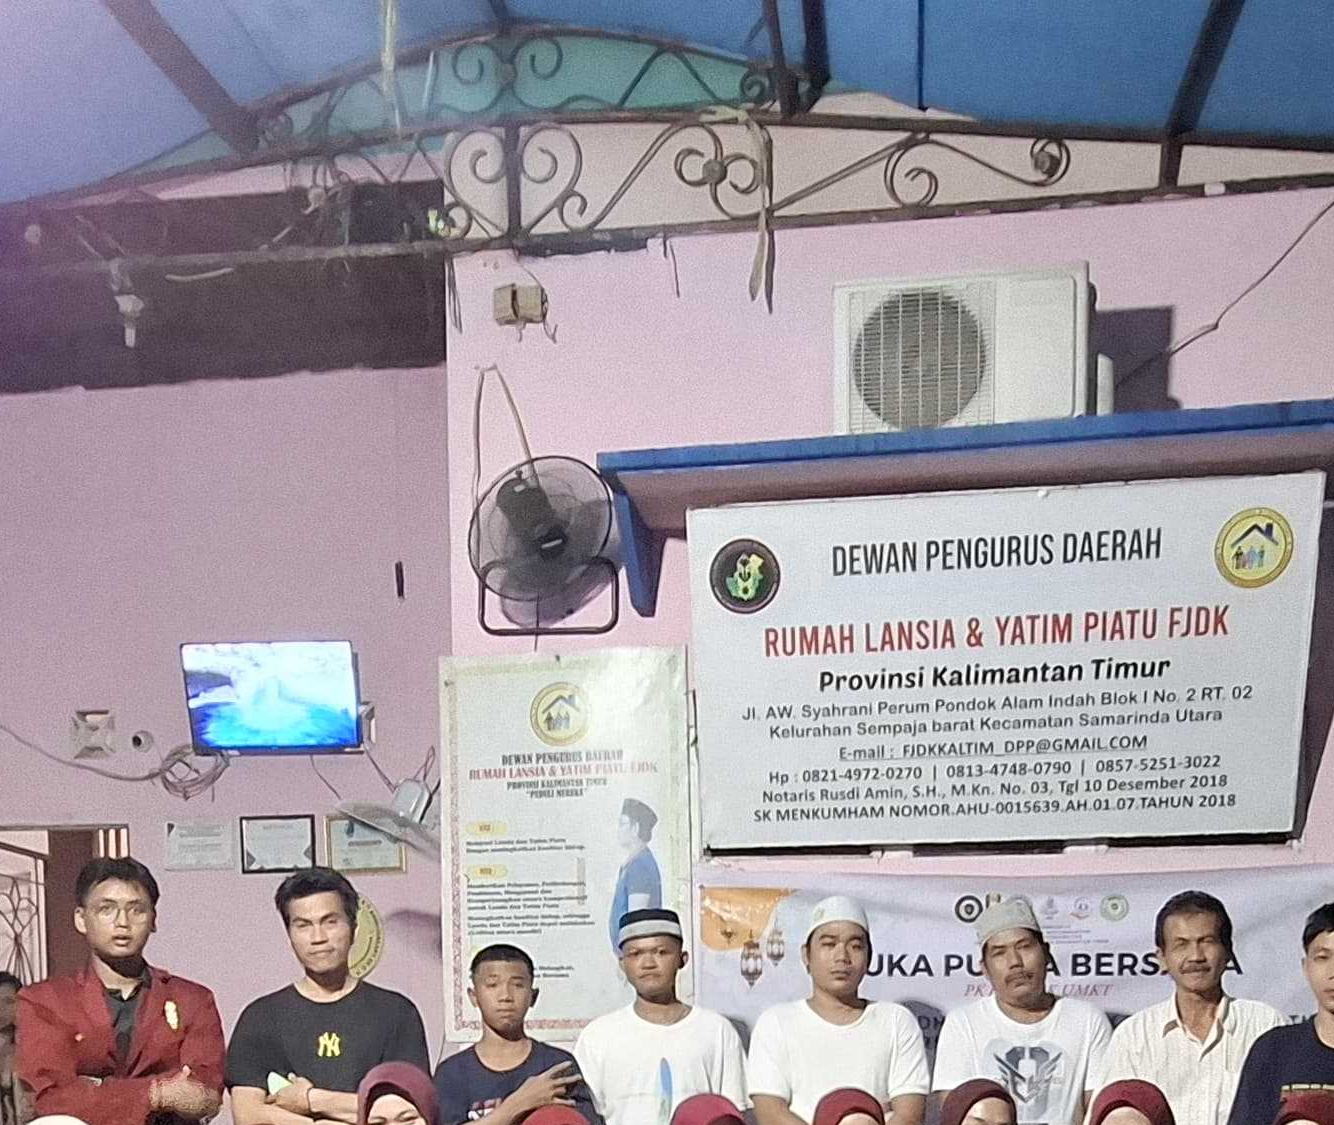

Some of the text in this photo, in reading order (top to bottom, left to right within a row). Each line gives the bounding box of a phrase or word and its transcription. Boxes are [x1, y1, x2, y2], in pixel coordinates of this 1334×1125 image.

[832, 527, 1163, 577] DEWAN PENGURUS DAERAH
[764, 605, 1230, 657] RUMAH LANSIA & YATIM PIATU FJDK
[819, 657, 1171, 693] Provinsi Kalimantan Timur
[801, 703, 873, 721] Syahrani
[877, 701, 930, 715] Perum
[935, 697, 997, 712] Pondok
[1001, 696, 1044, 710] Alam
[1049, 692, 1096, 708] Indah
[1101, 691, 1138, 706] Blok
[1186, 688, 1197, 702] 2
[1231, 685, 1253, 700] 02
[769, 708, 1223, 740] Kelurahan Sempaja barat Kecamatan Samarinda Utara
[839, 744, 885, 761] E-mail
[769, 770, 790, 786] Hp
[802, 766, 923, 783] 0821-4972-0270
[946, 760, 1072, 778] 0813-4748-0790
[1095, 754, 1221, 773] 0857-5251-3022
[762, 788, 816, 804] Notaris
[820, 786, 860, 802] Rusdi
[864, 785, 908, 801] Amin,
[1059, 779, 1079, 796] Tgl
[1084, 778, 1102, 793] 10
[1107, 776, 1186, 792] Desember
[1189, 774, 1228, 789] 2018
[753, 809, 772, 823] SK
[776, 805, 885, 822] MENKUMHAM
[1199, 793, 1236, 808] 2018
[867, 952, 1244, 977] UKA PUA BERSA
